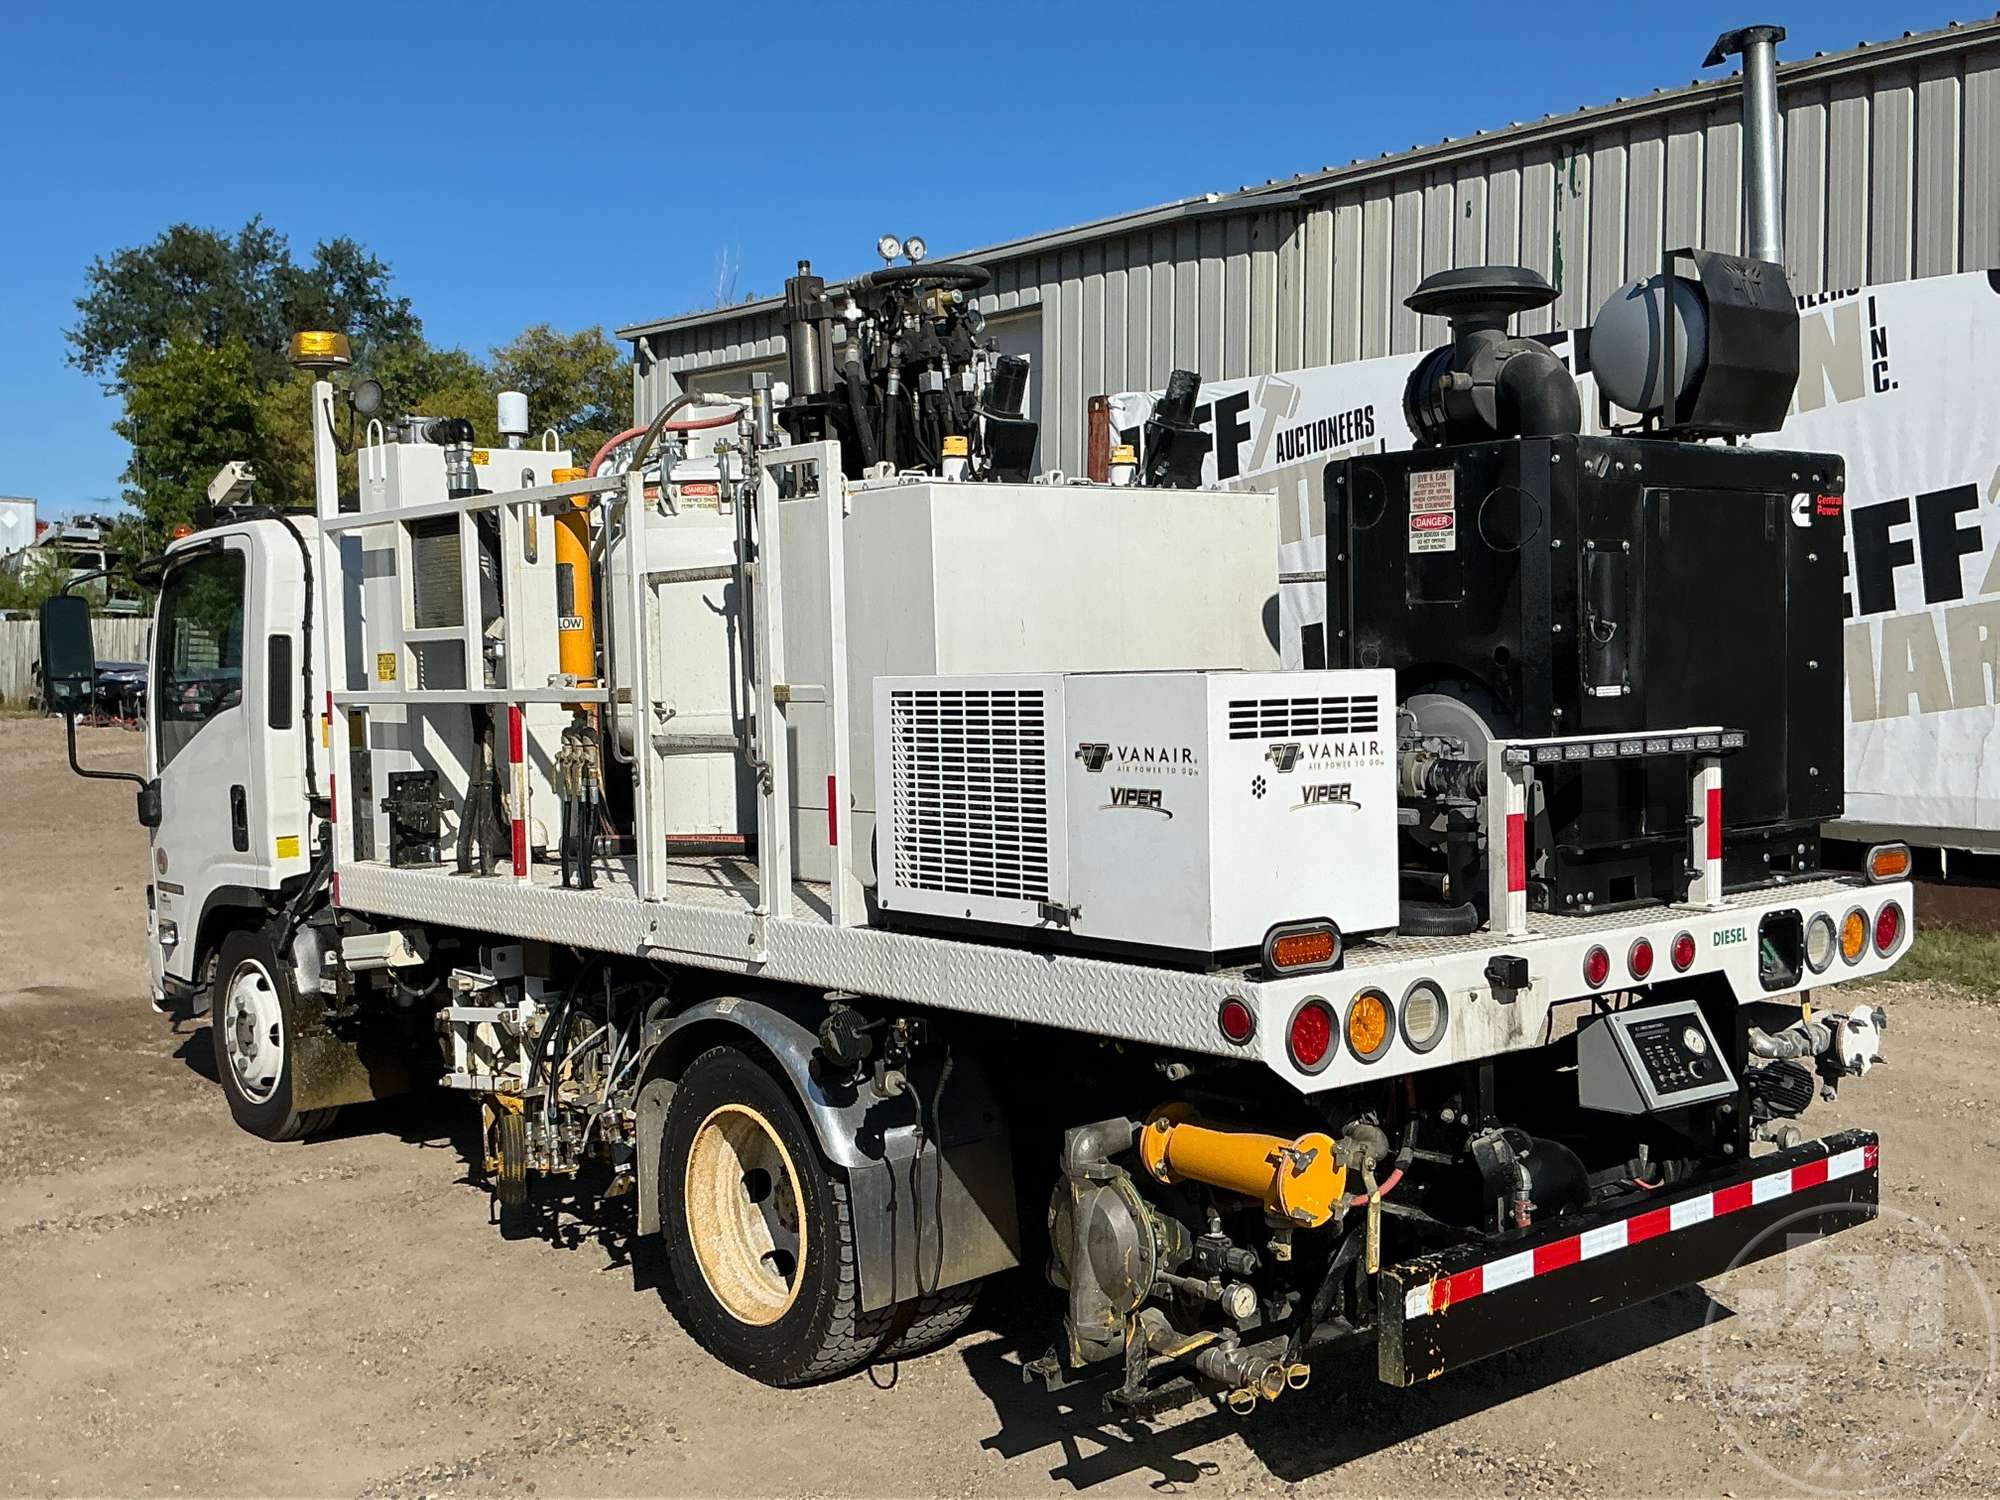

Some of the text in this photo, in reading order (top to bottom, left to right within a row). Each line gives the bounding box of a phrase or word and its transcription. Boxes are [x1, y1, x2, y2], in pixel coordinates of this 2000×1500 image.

[1276, 404, 1375, 464] AUCTIONEERS
[1817, 494, 1842, 505] Central
[1817, 505, 1840, 516] Power
[1416, 516, 1447, 527] DANGER
[1110, 787, 1162, 808] VIPER
[1301, 783, 1351, 804] VIPER
[1713, 928, 1747, 946] DIESEL
